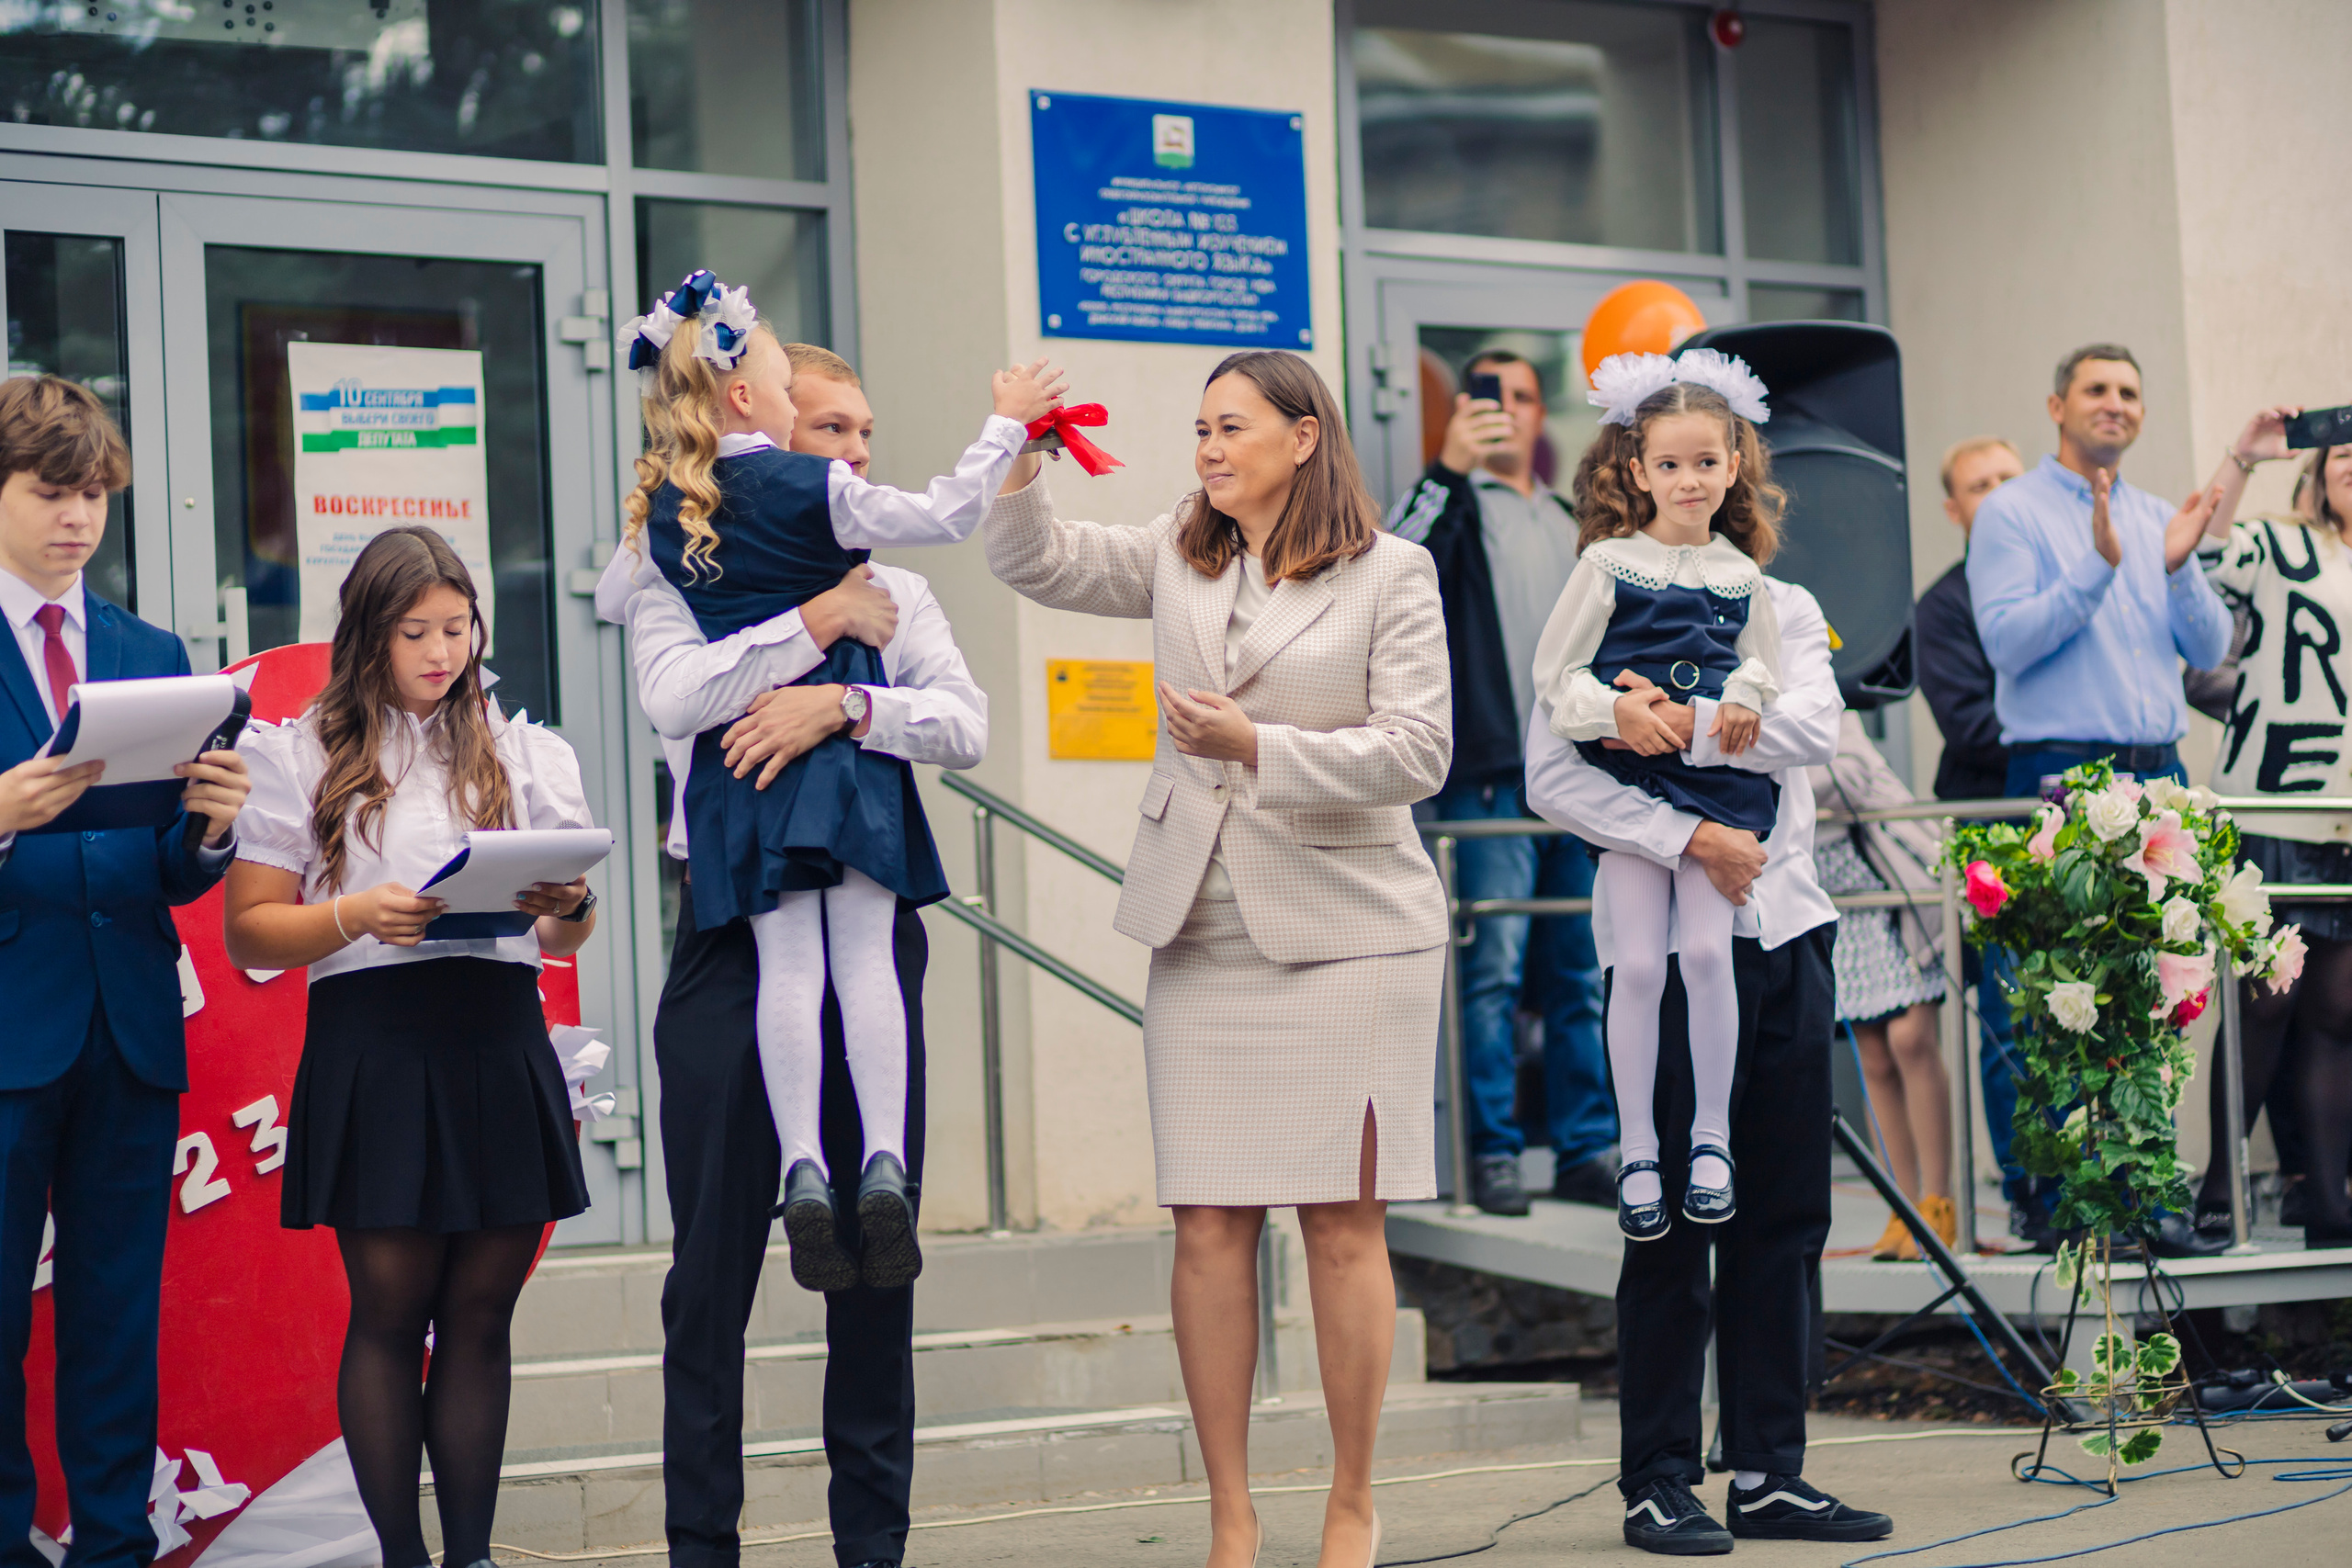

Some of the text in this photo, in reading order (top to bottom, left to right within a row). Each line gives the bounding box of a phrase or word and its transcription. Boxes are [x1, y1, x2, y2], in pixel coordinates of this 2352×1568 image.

[1064, 222, 1082, 243] С
[334, 378, 424, 408] 10 СЕНТЯБРЯ
[356, 431, 417, 447] ДЕПУТАТА
[313, 494, 472, 519] ВОСКРЕСЕНЬЕ
